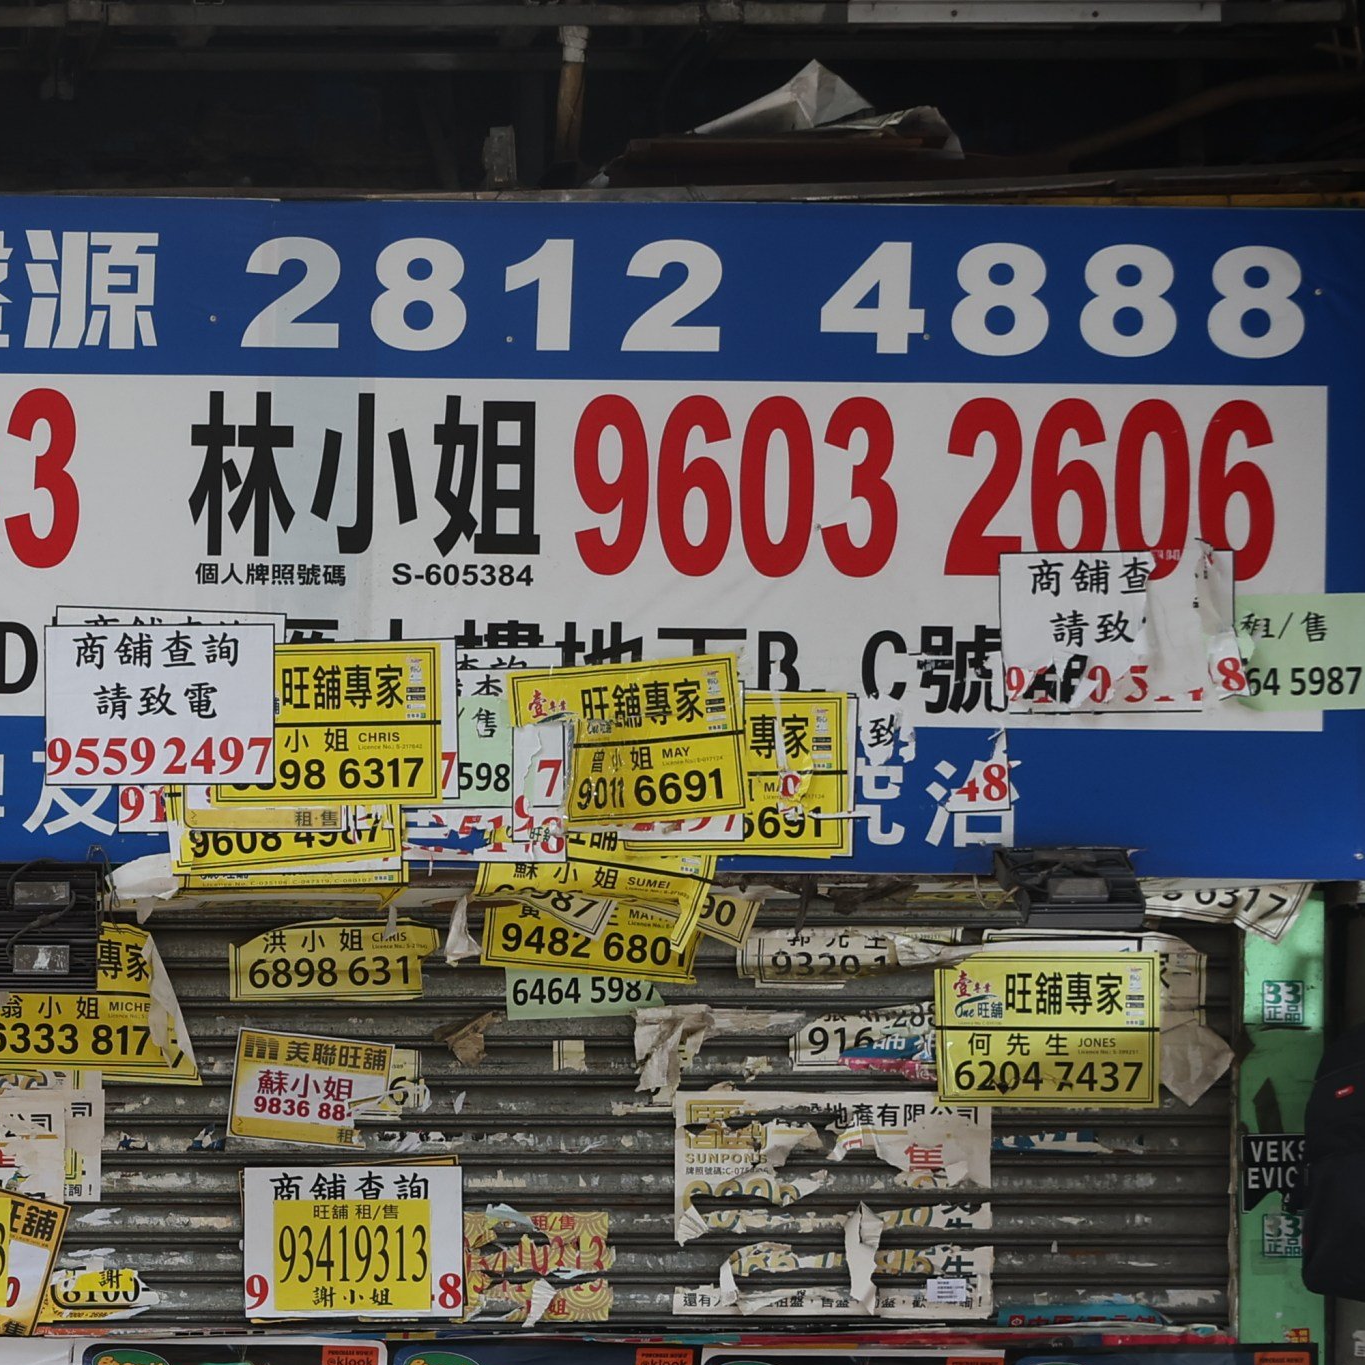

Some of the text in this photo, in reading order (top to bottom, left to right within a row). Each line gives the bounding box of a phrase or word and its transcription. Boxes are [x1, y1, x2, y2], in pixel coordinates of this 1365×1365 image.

[240, 236, 1306, 359] 2812 4888
[188, 391, 1276, 581] 林小姐 9603 2606
[194, 562, 535, 587] 個人牌照號碼 S-605384
[72, 632, 240, 670] 商舖查詢
[282, 664, 405, 711] 旺舖專家
[1290, 666, 1362, 696] 5987
[93, 682, 220, 721] 請致電
[580, 678, 705, 729] 旺舖專家
[357, 732, 401, 743] CHRIS
[661, 746, 691, 759] MAY
[338, 757, 425, 789] 6317
[633, 767, 723, 807] 6691
[262, 928, 364, 954] 洪小姐
[500, 922, 592, 959] 9482
[247, 957, 338, 989] 6898
[512, 977, 582, 1007] 6464
[1005, 971, 1124, 1016] 旺舖專家
[1263, 1003, 1304, 1023] 正品
[285, 1041, 387, 1073] 美聯旺舖
[968, 1032, 1117, 1057] 何先生 JONES
[257, 1069, 354, 1101] 蘇小姐
[955, 1060, 1144, 1092] 6204 7437
[253, 1096, 310, 1119] 9836
[312, 1204, 399, 1221] 旺舖 租/售
[279, 1224, 428, 1284] 93419313
[312, 1285, 394, 1306] 謝小姐
